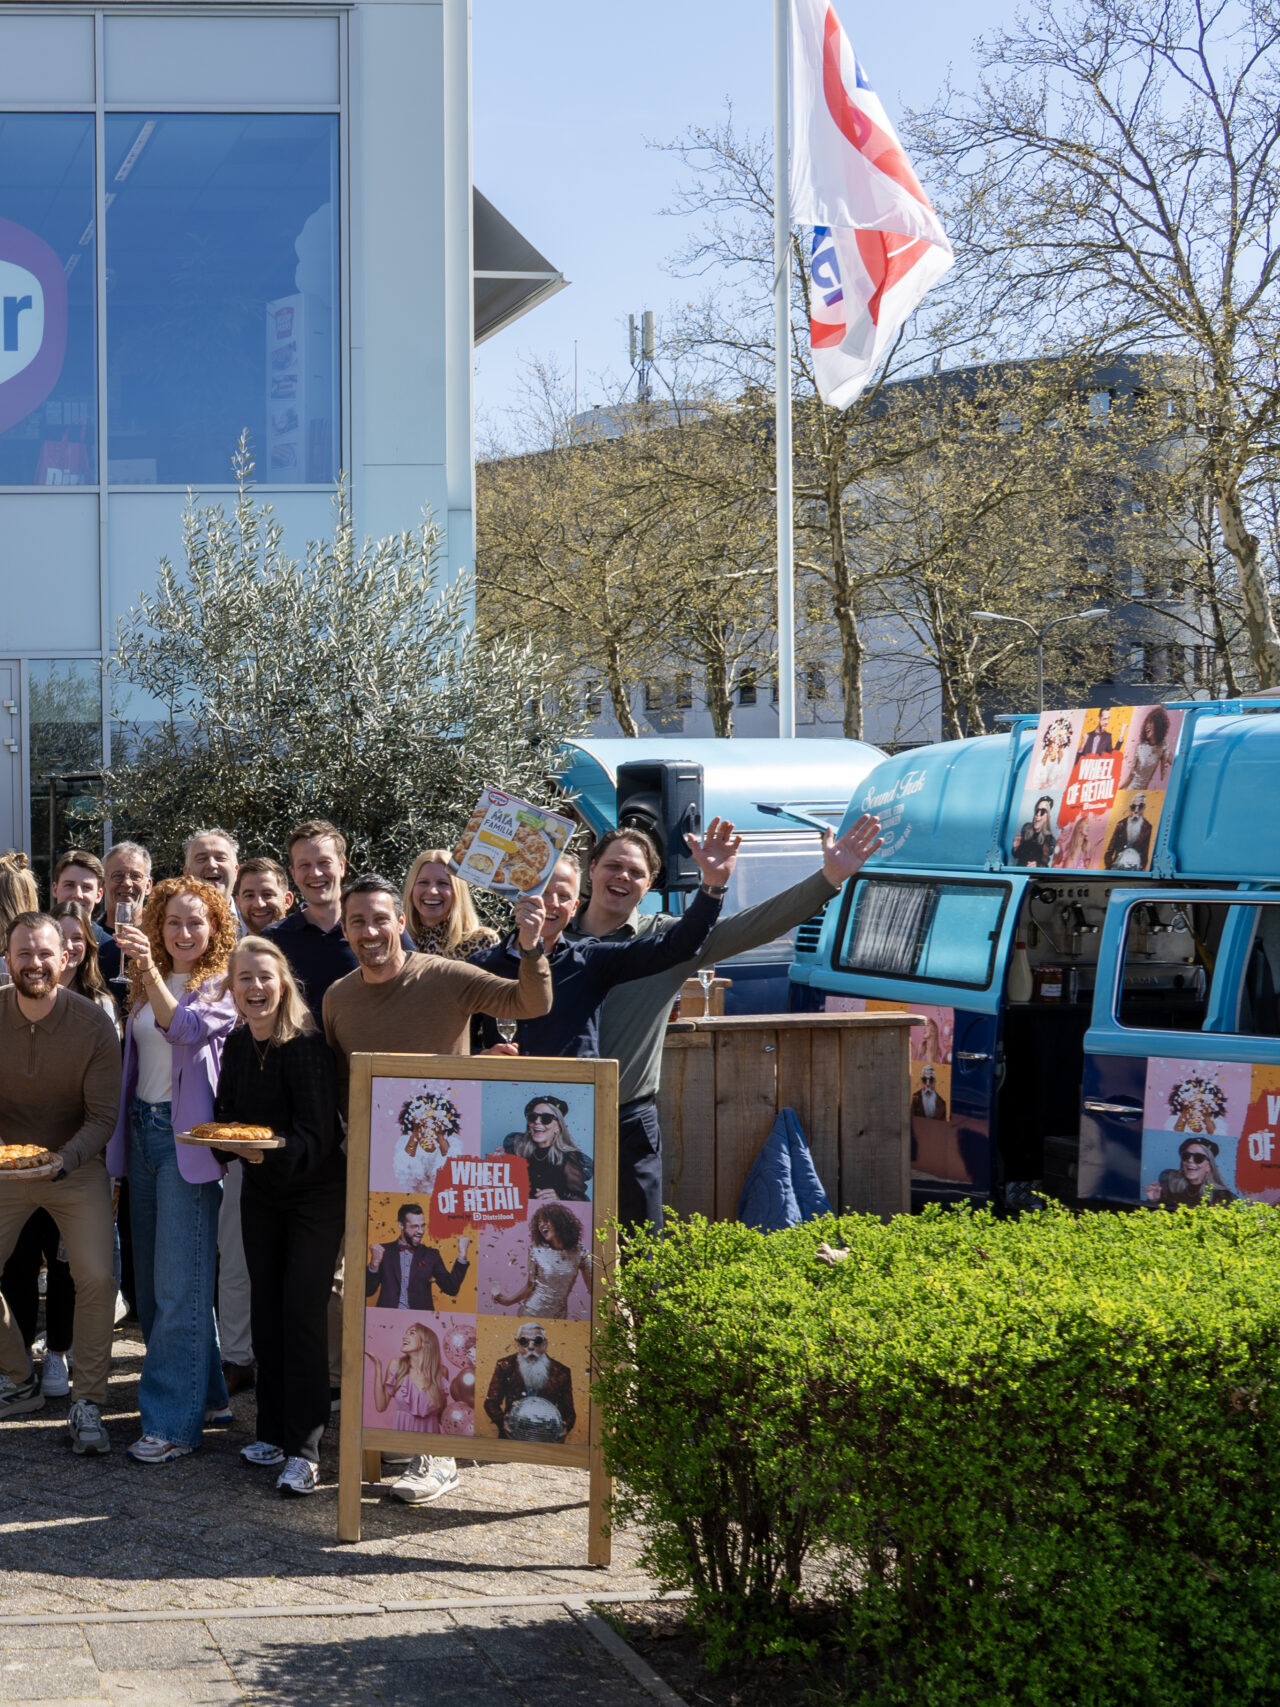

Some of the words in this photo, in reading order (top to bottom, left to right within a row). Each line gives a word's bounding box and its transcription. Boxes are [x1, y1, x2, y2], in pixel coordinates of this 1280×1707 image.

[1078, 758, 1115, 780] WHEEL
[861, 779, 900, 812] Sound
[1066, 784, 1081, 805] OF
[1080, 779, 1115, 803] RETAIL
[483, 819, 514, 837] FAMILIA
[491, 811, 513, 828] MIA
[1248, 1130, 1276, 1161] OF
[451, 1161, 513, 1187] WHEEL
[438, 1191, 458, 1214] OF
[463, 1187, 524, 1212] RETAIL
